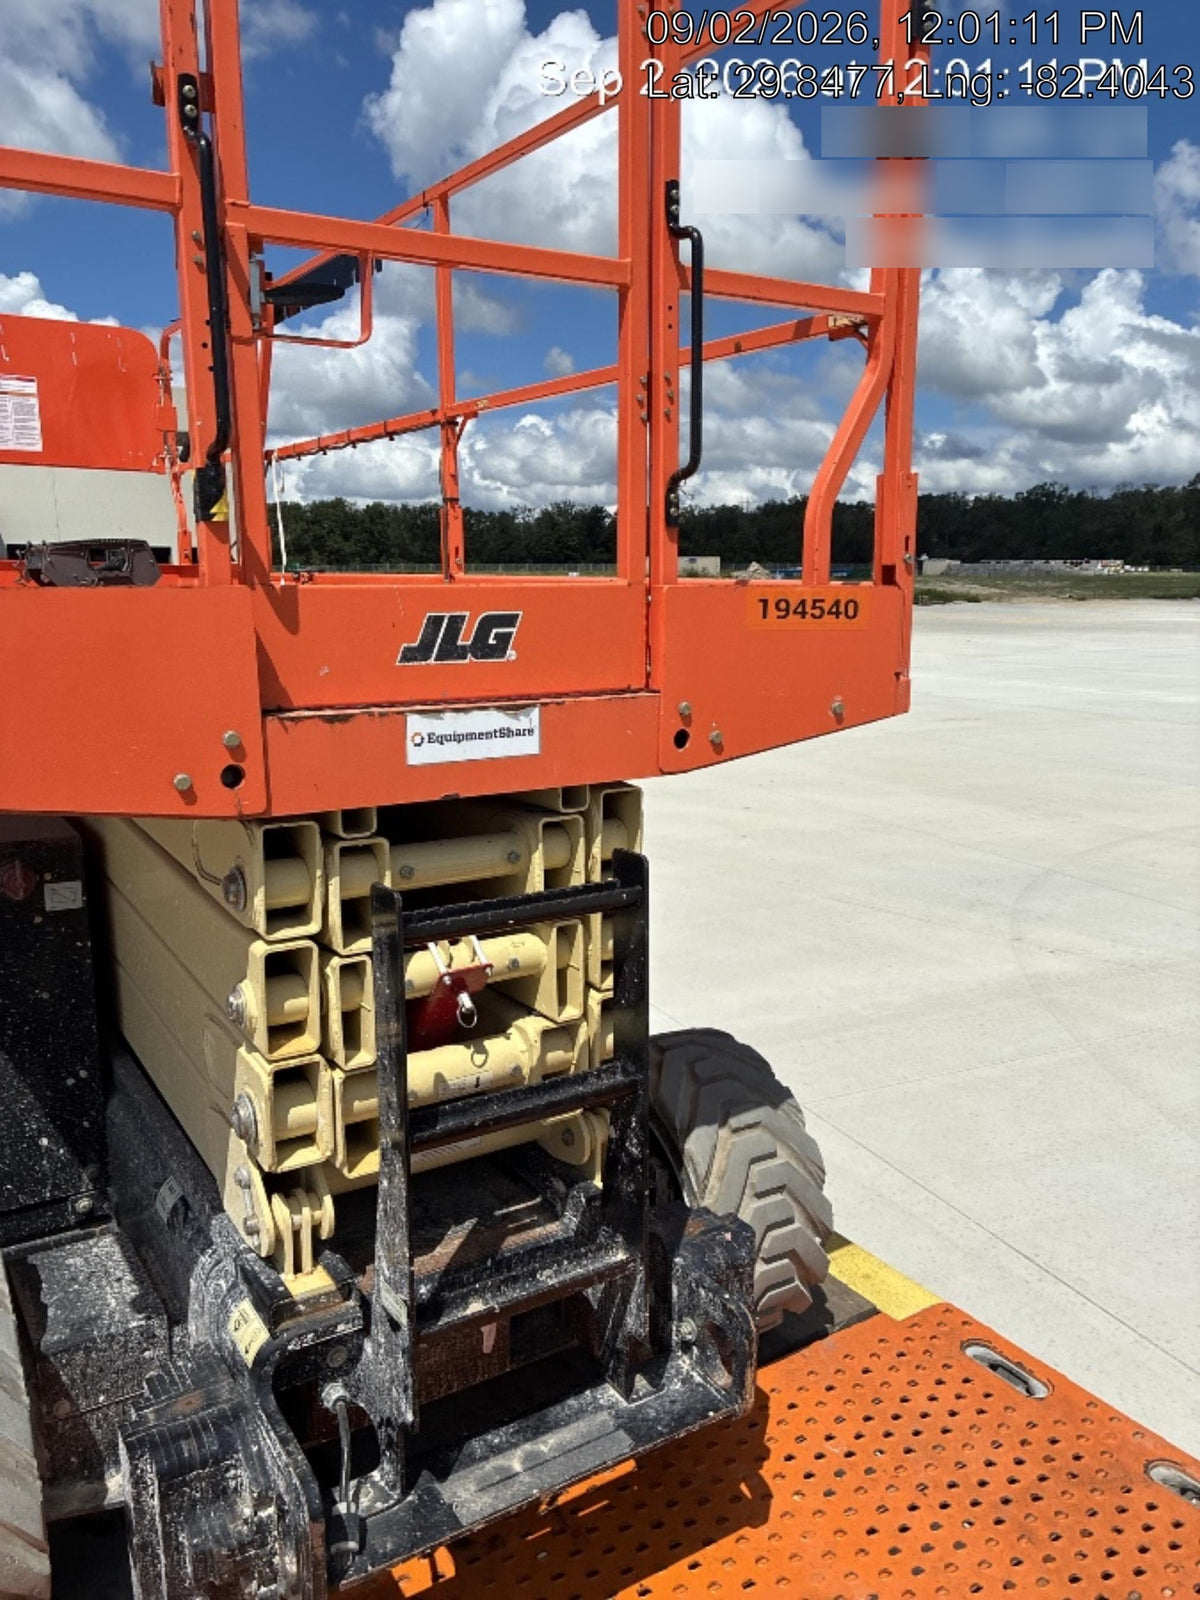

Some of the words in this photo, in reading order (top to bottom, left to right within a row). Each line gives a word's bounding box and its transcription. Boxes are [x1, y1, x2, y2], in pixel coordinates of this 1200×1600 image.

[758, 598, 859, 620] 194540
[396, 611, 523, 665] JLG
[426, 726, 535, 746] EquipmentShare
